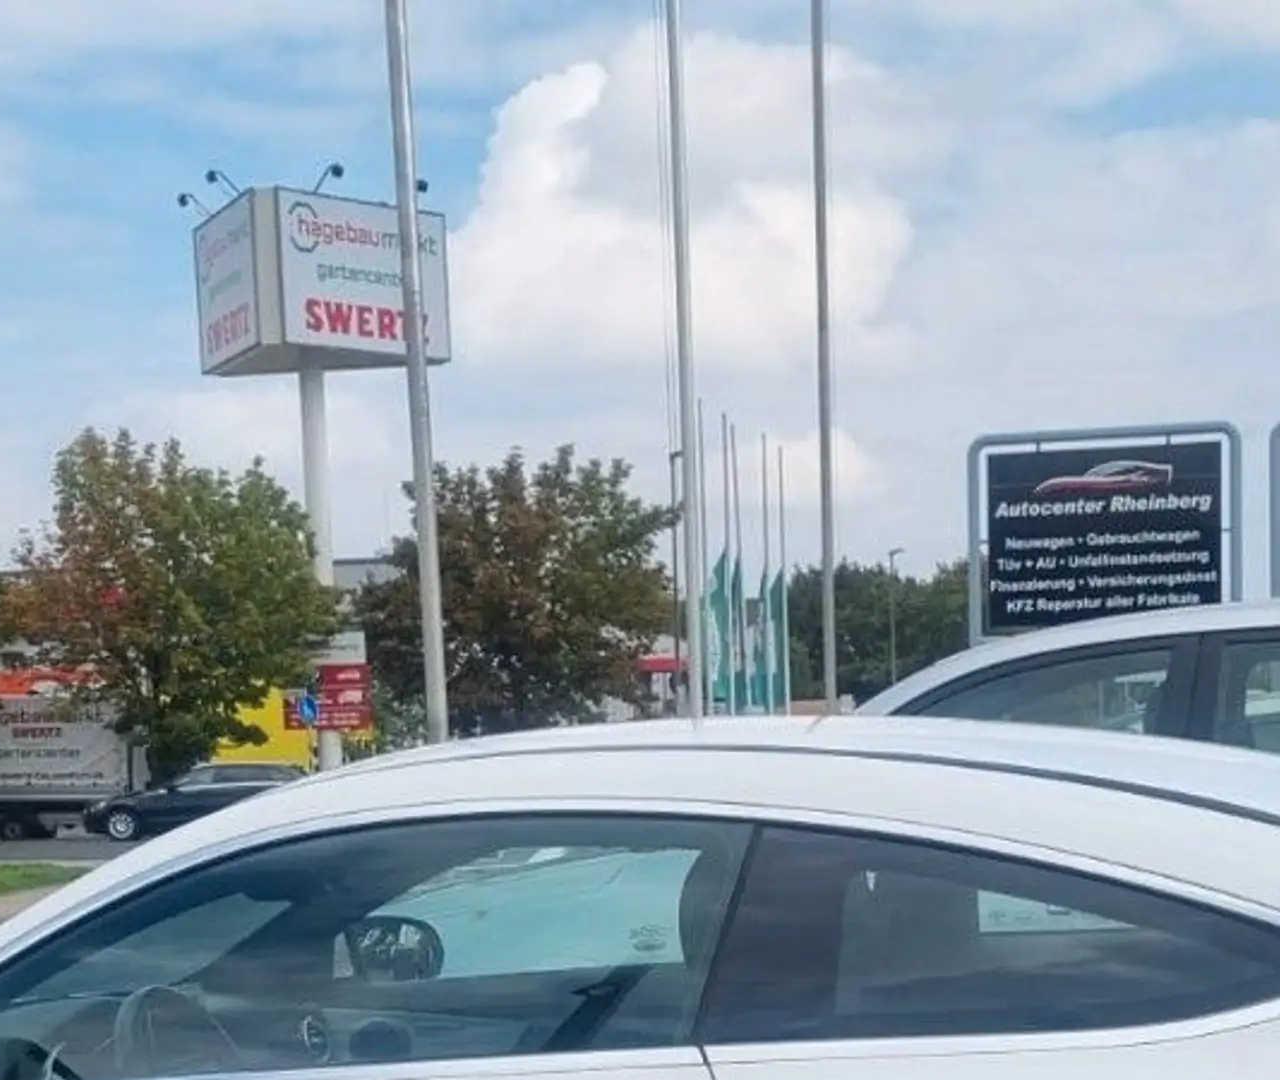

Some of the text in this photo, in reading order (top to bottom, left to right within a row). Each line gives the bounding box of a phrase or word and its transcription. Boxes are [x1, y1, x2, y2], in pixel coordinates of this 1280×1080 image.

[297, 214, 438, 256] hagebaumkt
[995, 493, 1213, 518] Autocenter Rheinberg
[1005, 529, 1202, 551] Neuwagen Gebrauchtwagen
[1036, 556, 1057, 569] AU
[990, 578, 1076, 593] Finanzierung
[1006, 600, 1035, 613] KFZ
